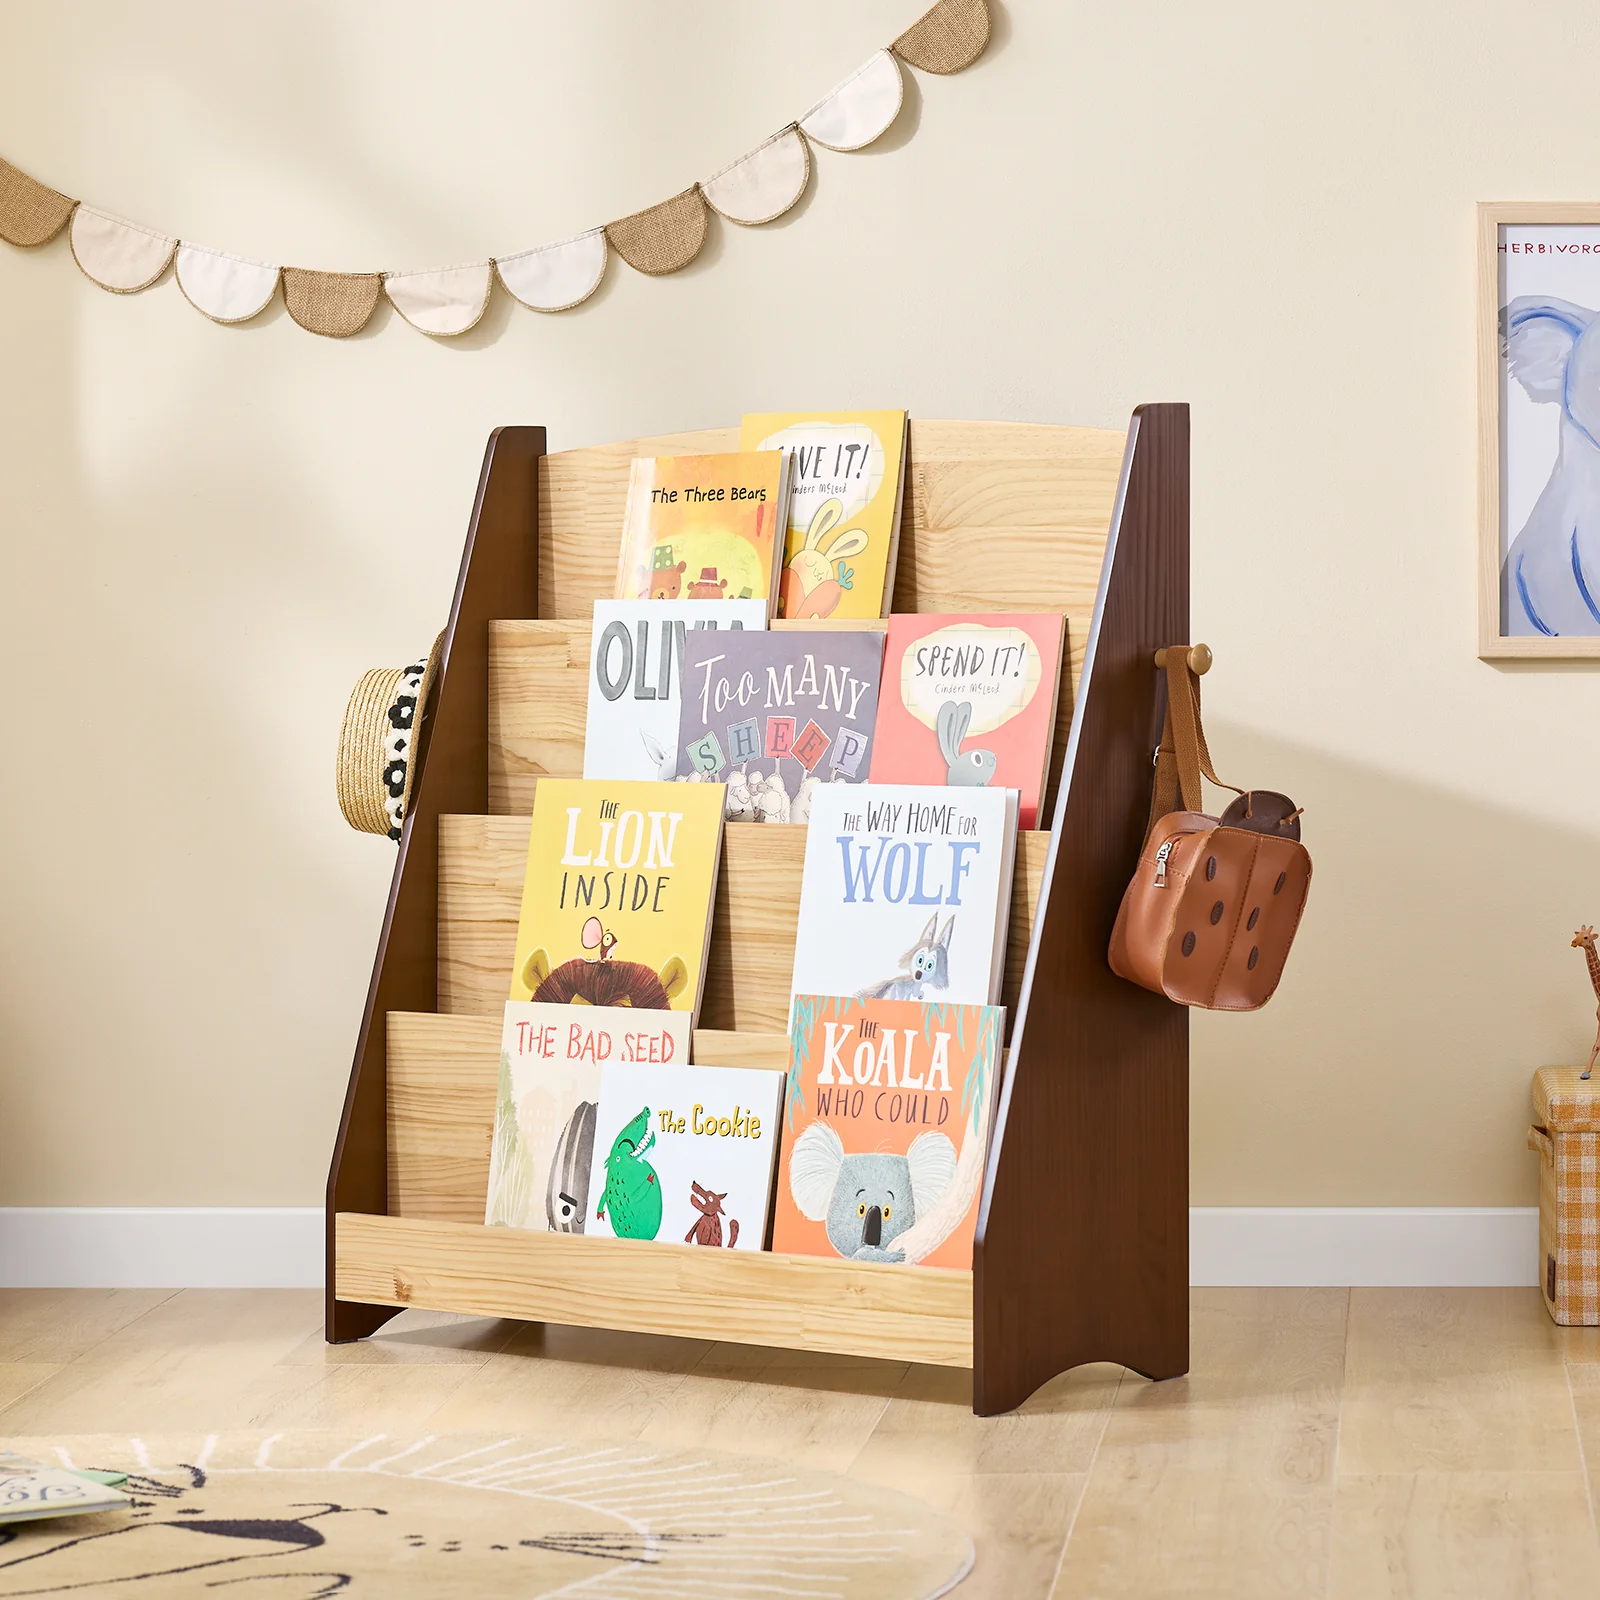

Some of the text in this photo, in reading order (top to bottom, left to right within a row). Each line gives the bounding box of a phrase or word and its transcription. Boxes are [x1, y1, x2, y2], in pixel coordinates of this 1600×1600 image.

[834, 444, 869, 479] IT!
[651, 486, 767, 503] The Three Bears
[792, 484, 815, 495] inders
[916, 642, 1026, 678] SPEND IT!
[695, 654, 871, 724] Too MANY
[935, 683, 966, 694] Cinders
[699, 722, 859, 771] SHEEP
[866, 801, 903, 833] WAY
[906, 803, 957, 835] HOME
[957, 815, 978, 836] FOR
[836, 836, 981, 906] WOLF
[559, 871, 670, 913] INSIDE
[515, 1020, 675, 1065] THE BAD SEED
[658, 1103, 762, 1139] The Cookie
[817, 1087, 950, 1126] WHO COULD
